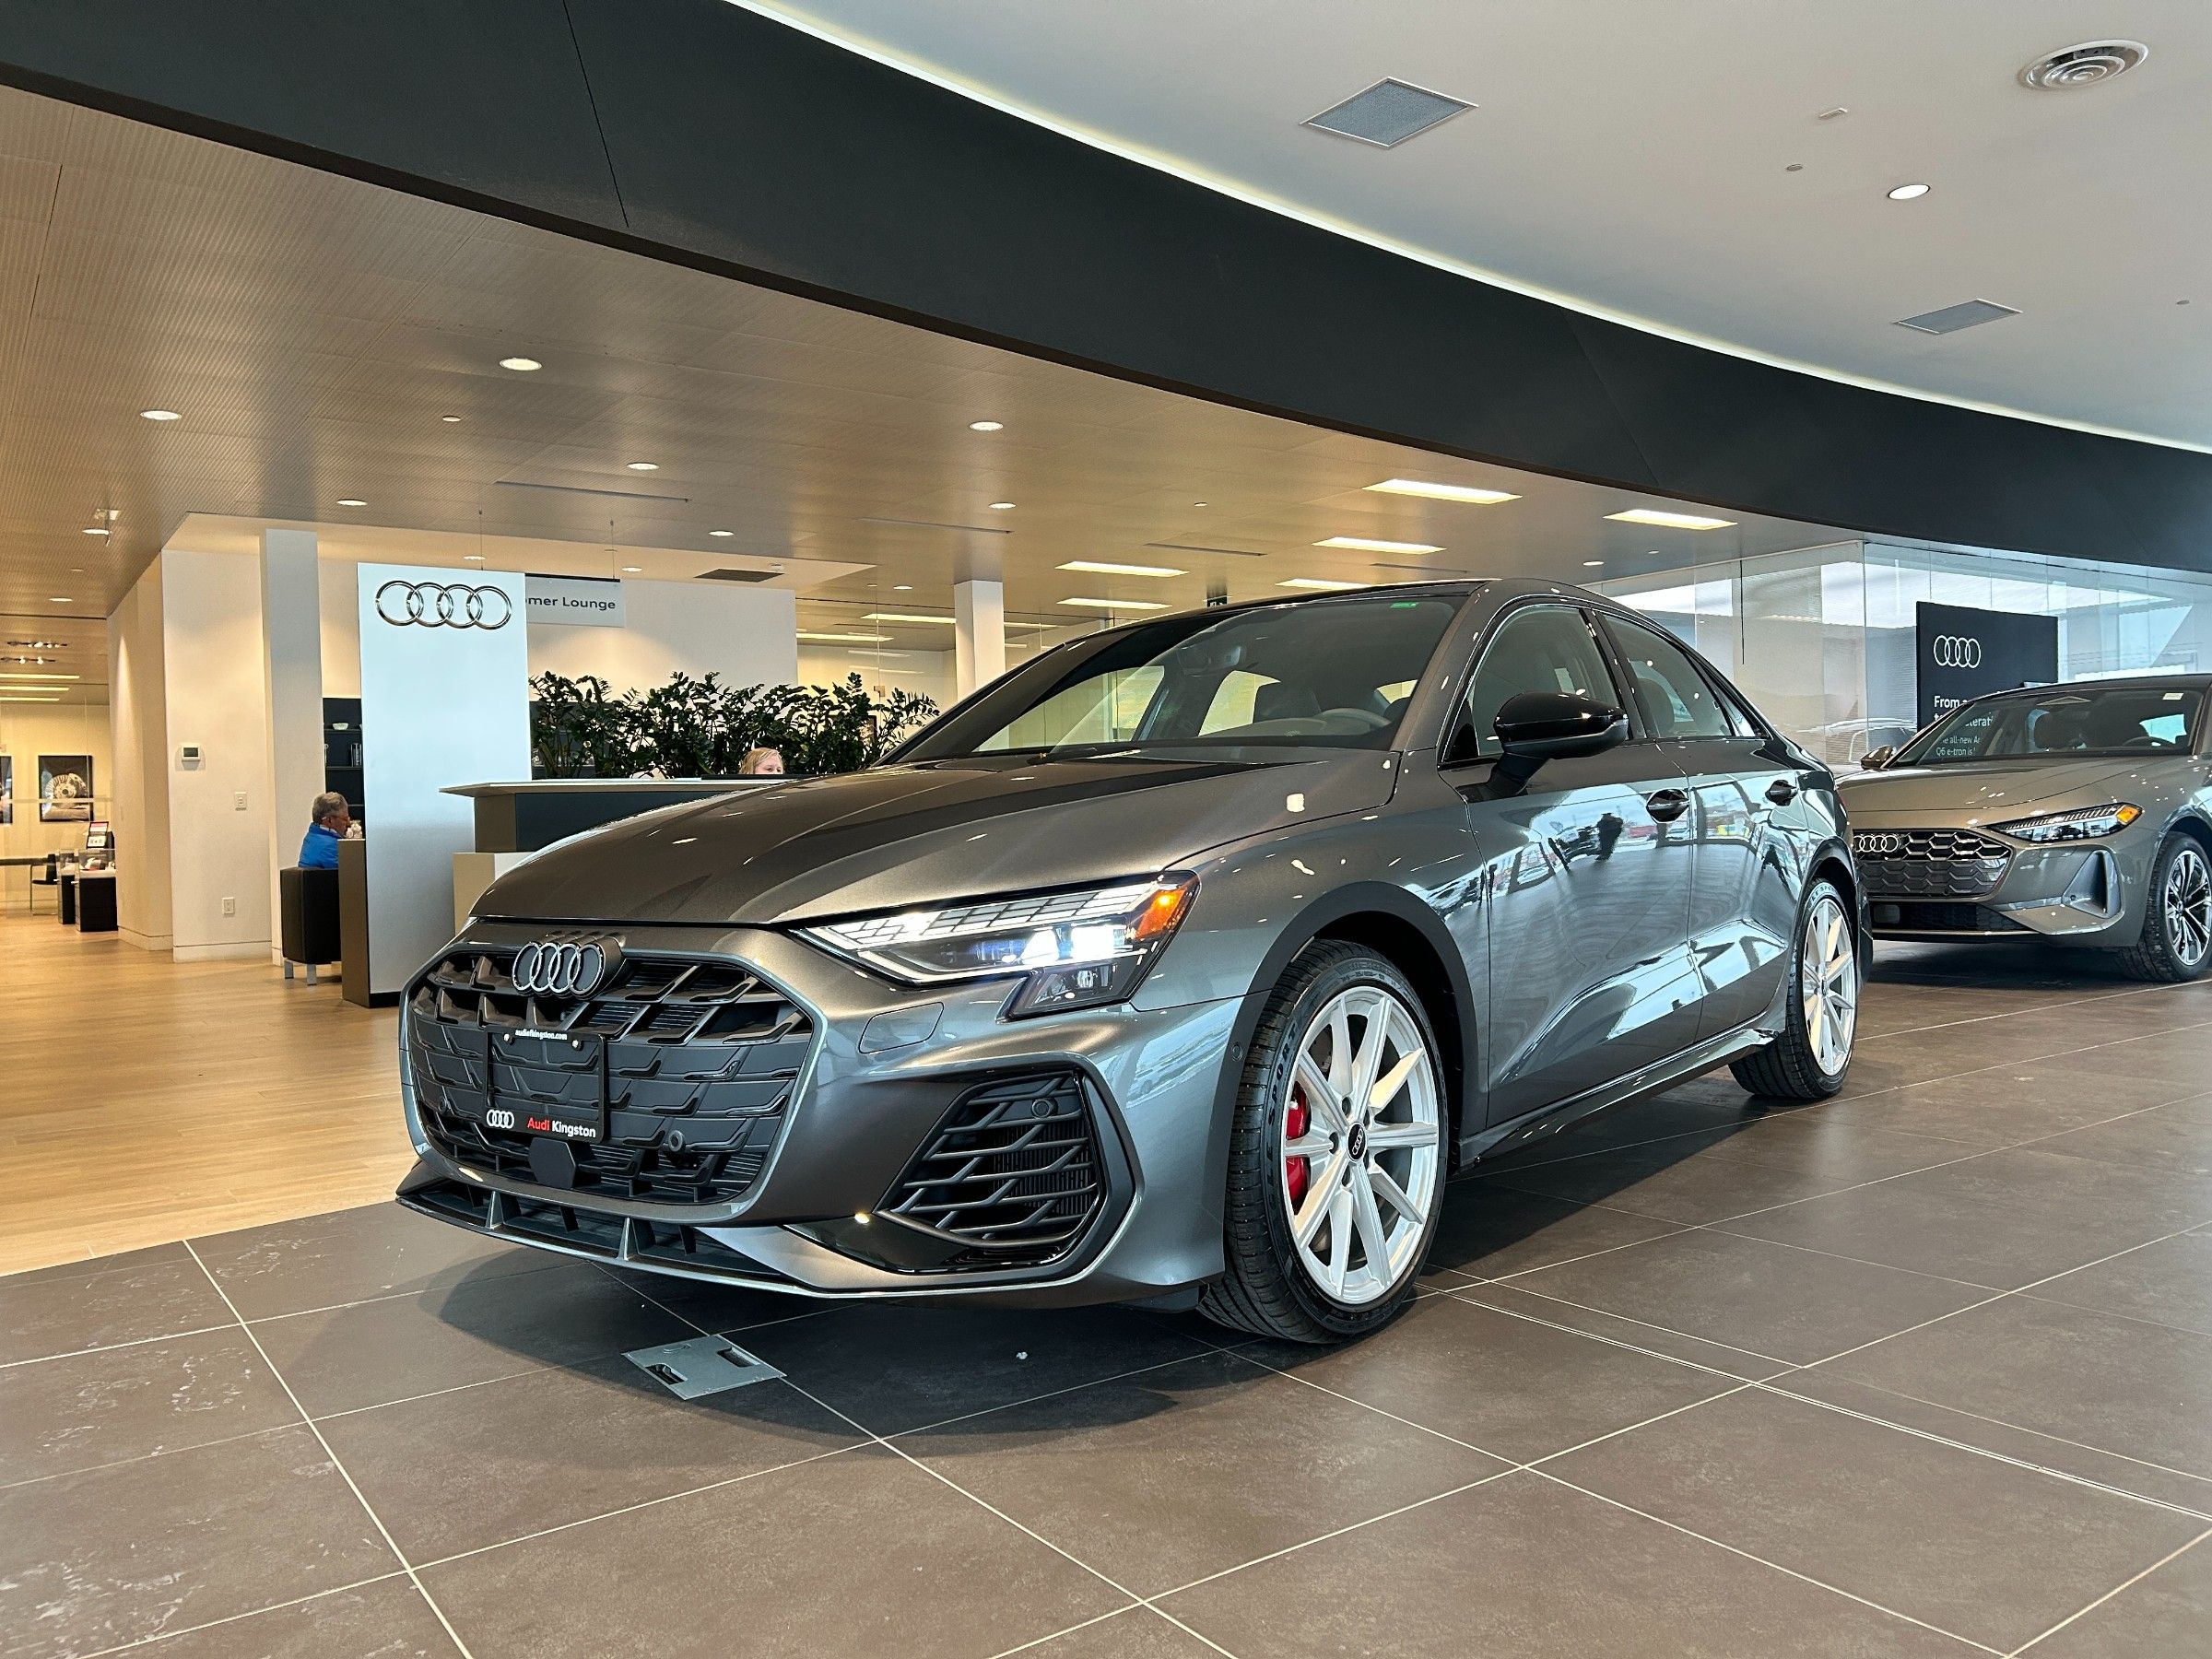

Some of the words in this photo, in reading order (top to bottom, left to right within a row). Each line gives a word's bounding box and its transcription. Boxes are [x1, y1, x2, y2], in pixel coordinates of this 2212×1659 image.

[525, 597, 558, 606] mer
[562, 597, 616, 611] Lounge
[1934, 695, 1960, 709] From
[1949, 735, 1972, 744] all-new
[1936, 747, 1946, 757] Q6
[1947, 747, 1967, 756] e-tron
[1267, 1022, 1296, 1126] SPORT
[527, 1117, 550, 1131] Audi
[551, 1120, 596, 1138] Kingston
